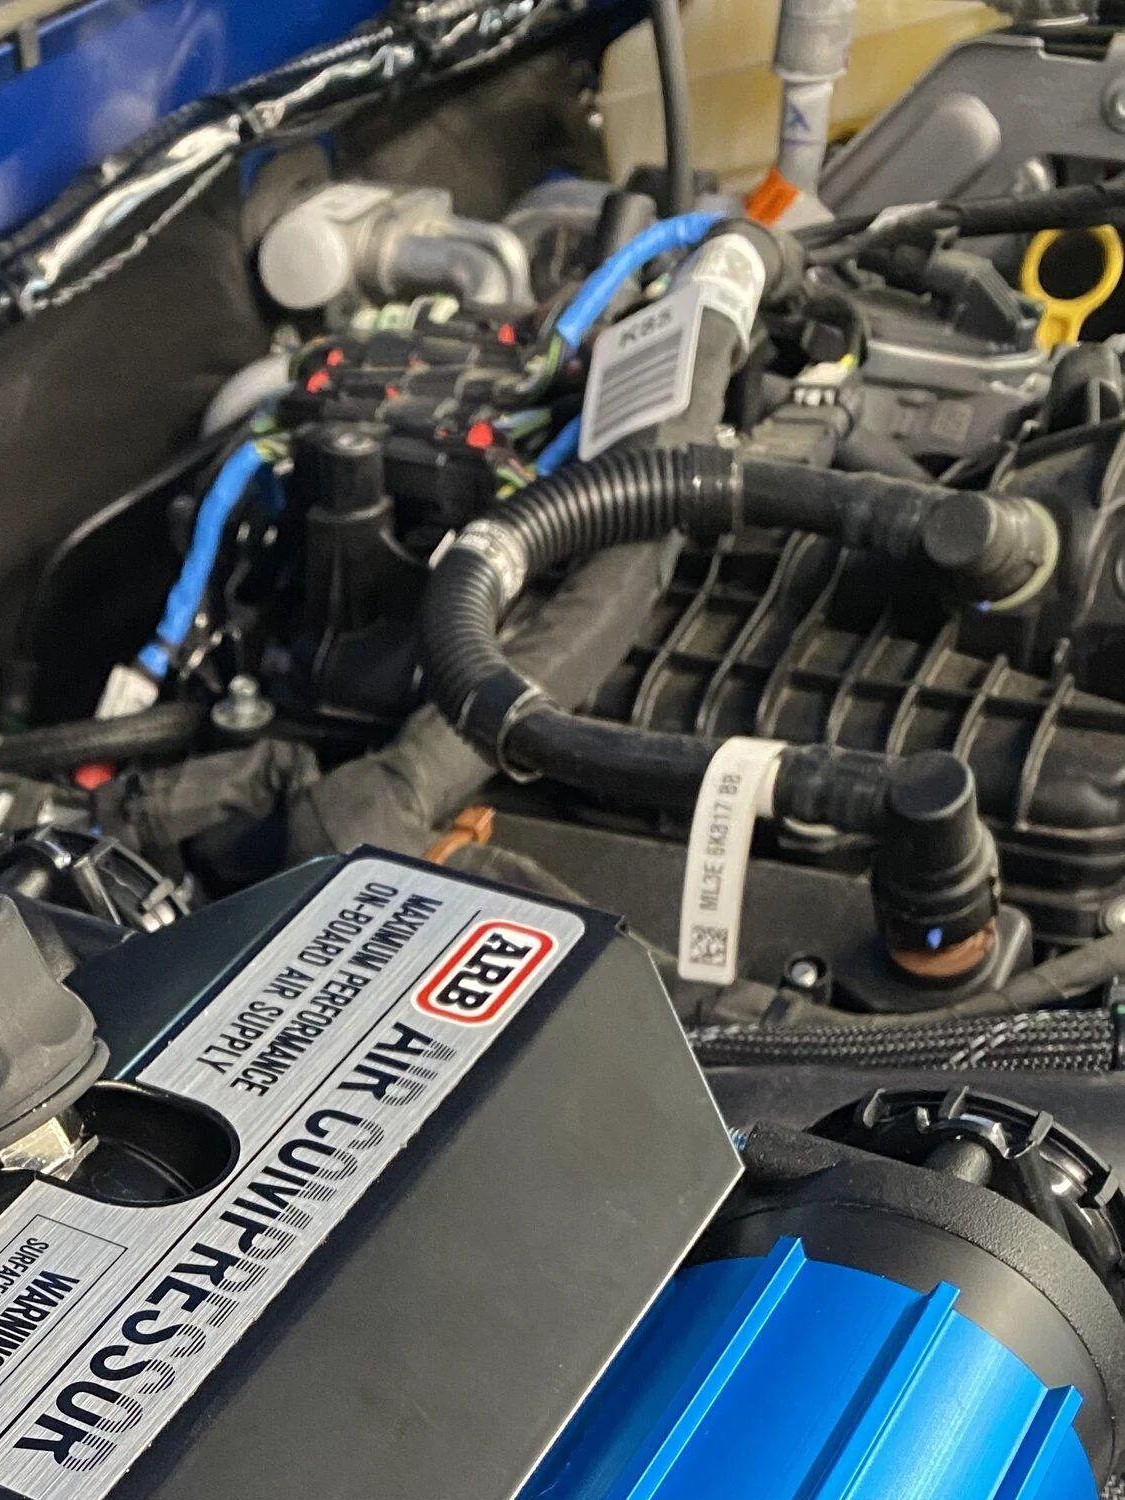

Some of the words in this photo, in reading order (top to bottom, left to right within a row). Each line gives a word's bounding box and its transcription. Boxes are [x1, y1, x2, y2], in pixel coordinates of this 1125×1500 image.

[297, 882, 399, 968] ON-BOARD
[347, 893, 444, 973] MAXIMUM
[263, 966, 315, 1001] AIR
[436, 932, 533, 1010] ARB
[196, 1000, 285, 1075] SUPPLY
[229, 969, 372, 1098] PERFORMANCE
[336, 1021, 457, 1107] AIR
[13, 1109, 385, 1473] COMPRESSOR
